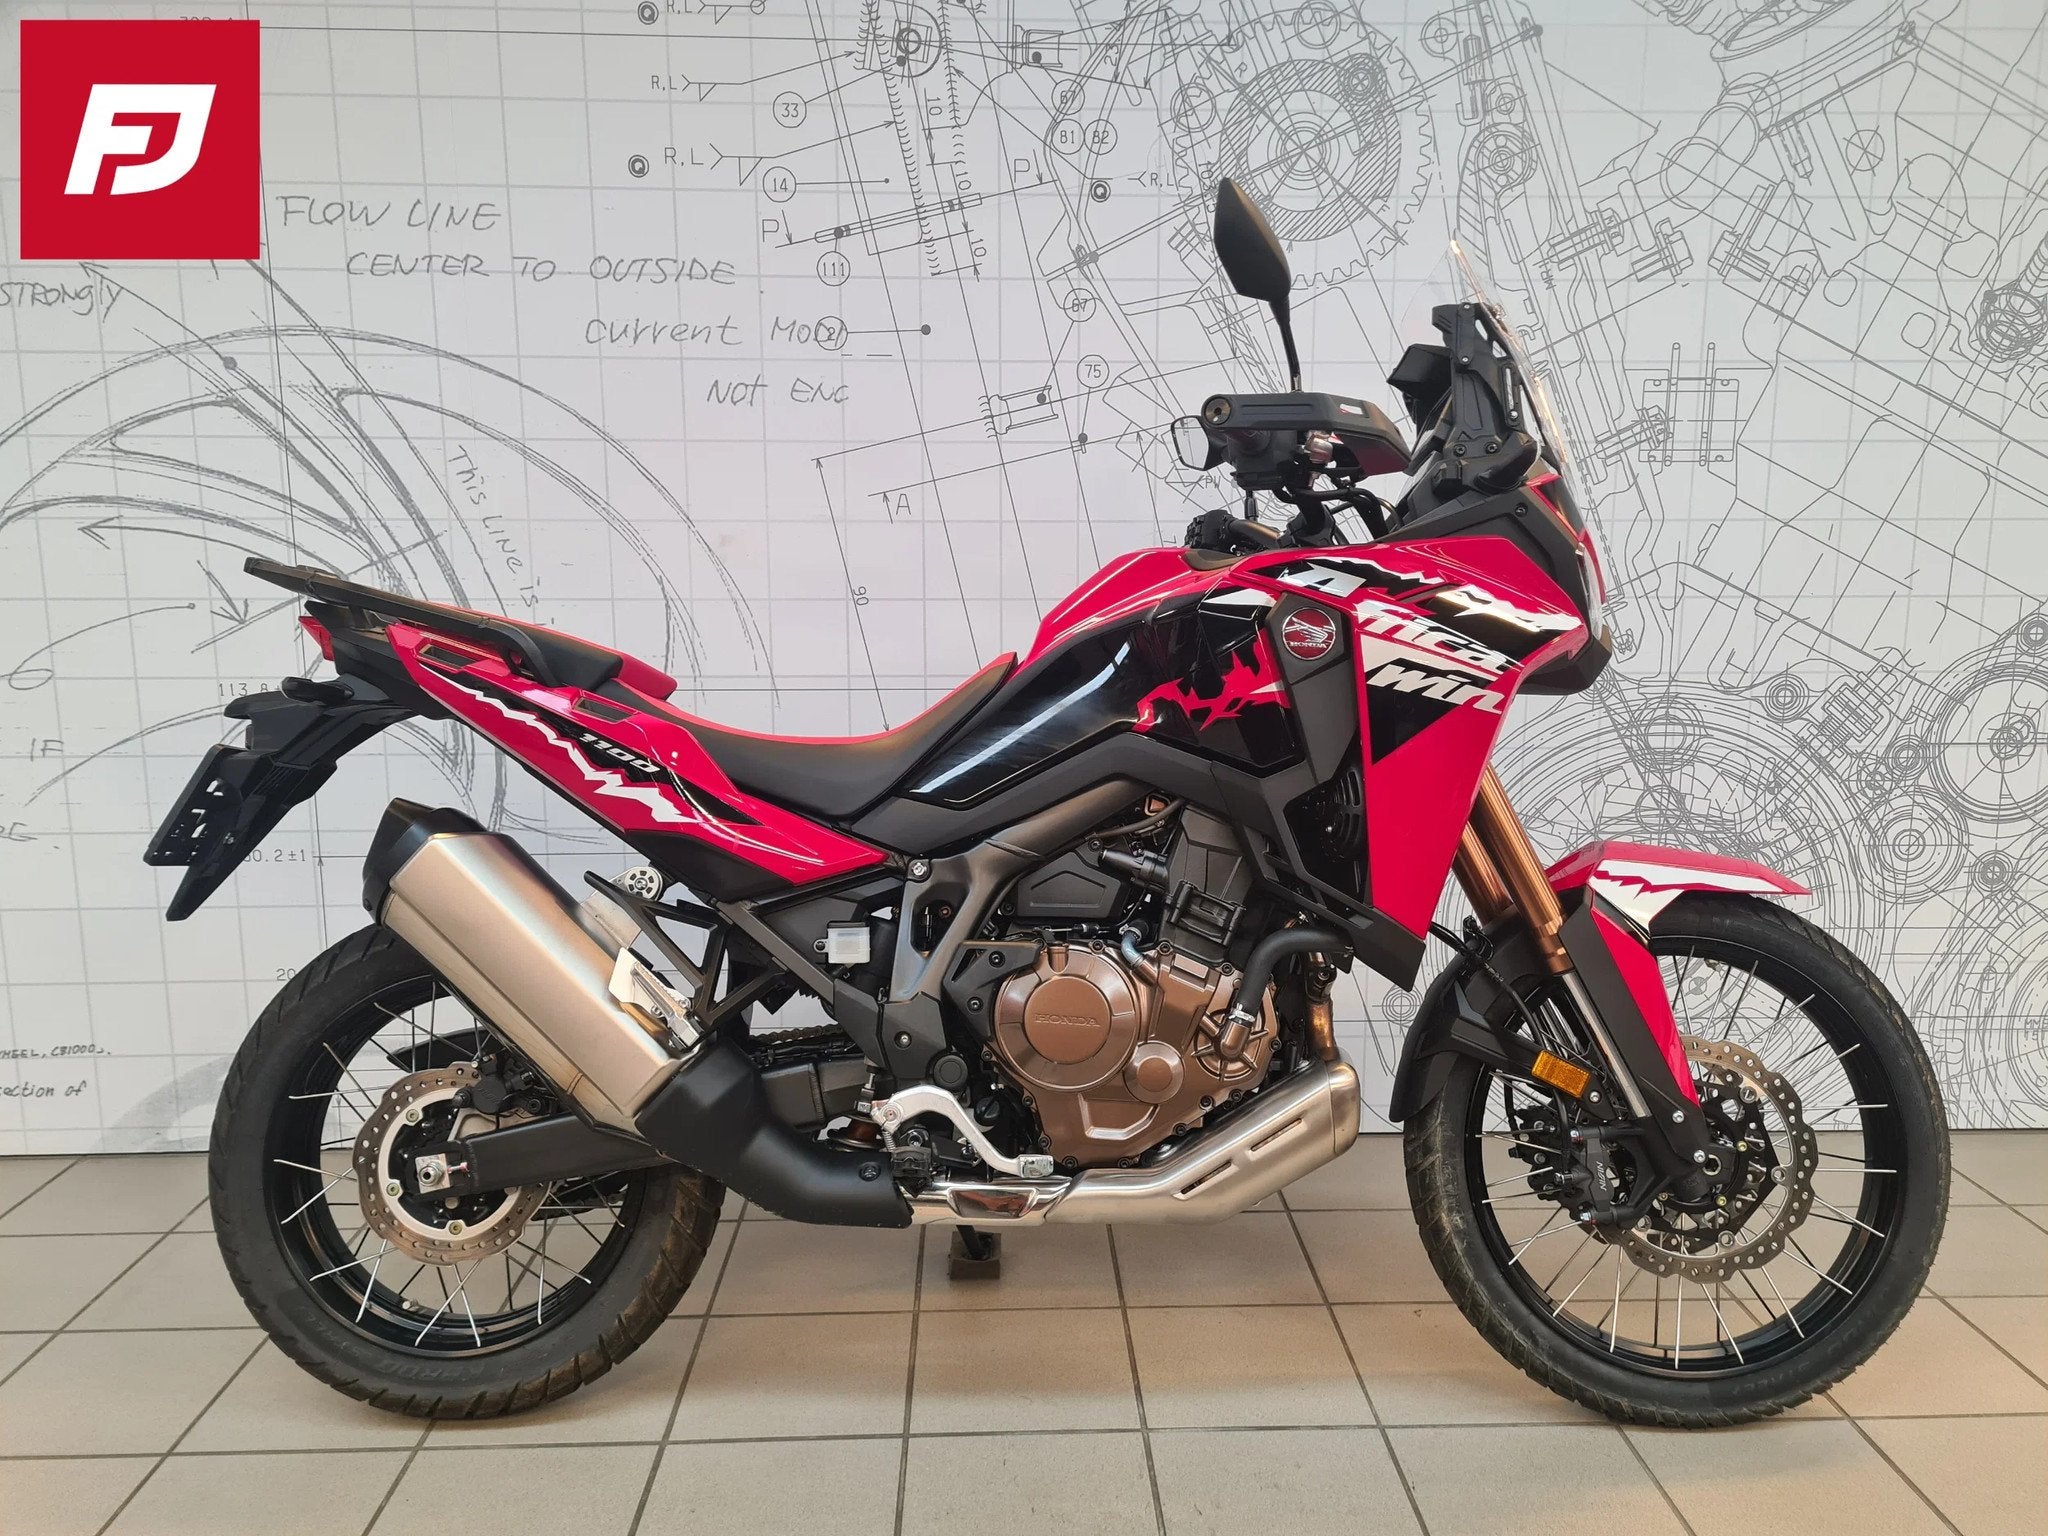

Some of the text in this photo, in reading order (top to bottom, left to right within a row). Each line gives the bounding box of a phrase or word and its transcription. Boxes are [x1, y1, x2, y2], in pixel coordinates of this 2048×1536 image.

[651, 75, 677, 91] R,L
[781, 102, 799, 118] 33
[927, 96, 942, 116] 10
[1060, 130, 1075, 144] 81
[664, 147, 704, 166] R,L
[1013, 158, 1031, 183] P
[772, 178, 788, 192] 14
[955, 171, 972, 191] 10
[276, 195, 502, 231] FLOW LINE
[762, 219, 779, 242] P
[970, 238, 987, 258] 10
[347, 252, 735, 285] CENTER TO OUTSIDE
[823, 262, 846, 277] 111
[1085, 364, 1101, 378] 75
[896, 493, 911, 515] A
[853, 586, 869, 606] 90
[1290, 641, 1328, 649] HONDA
[1034, 1013, 1101, 1028] HONDA
[0, 1080, 87, 1098] ection of
